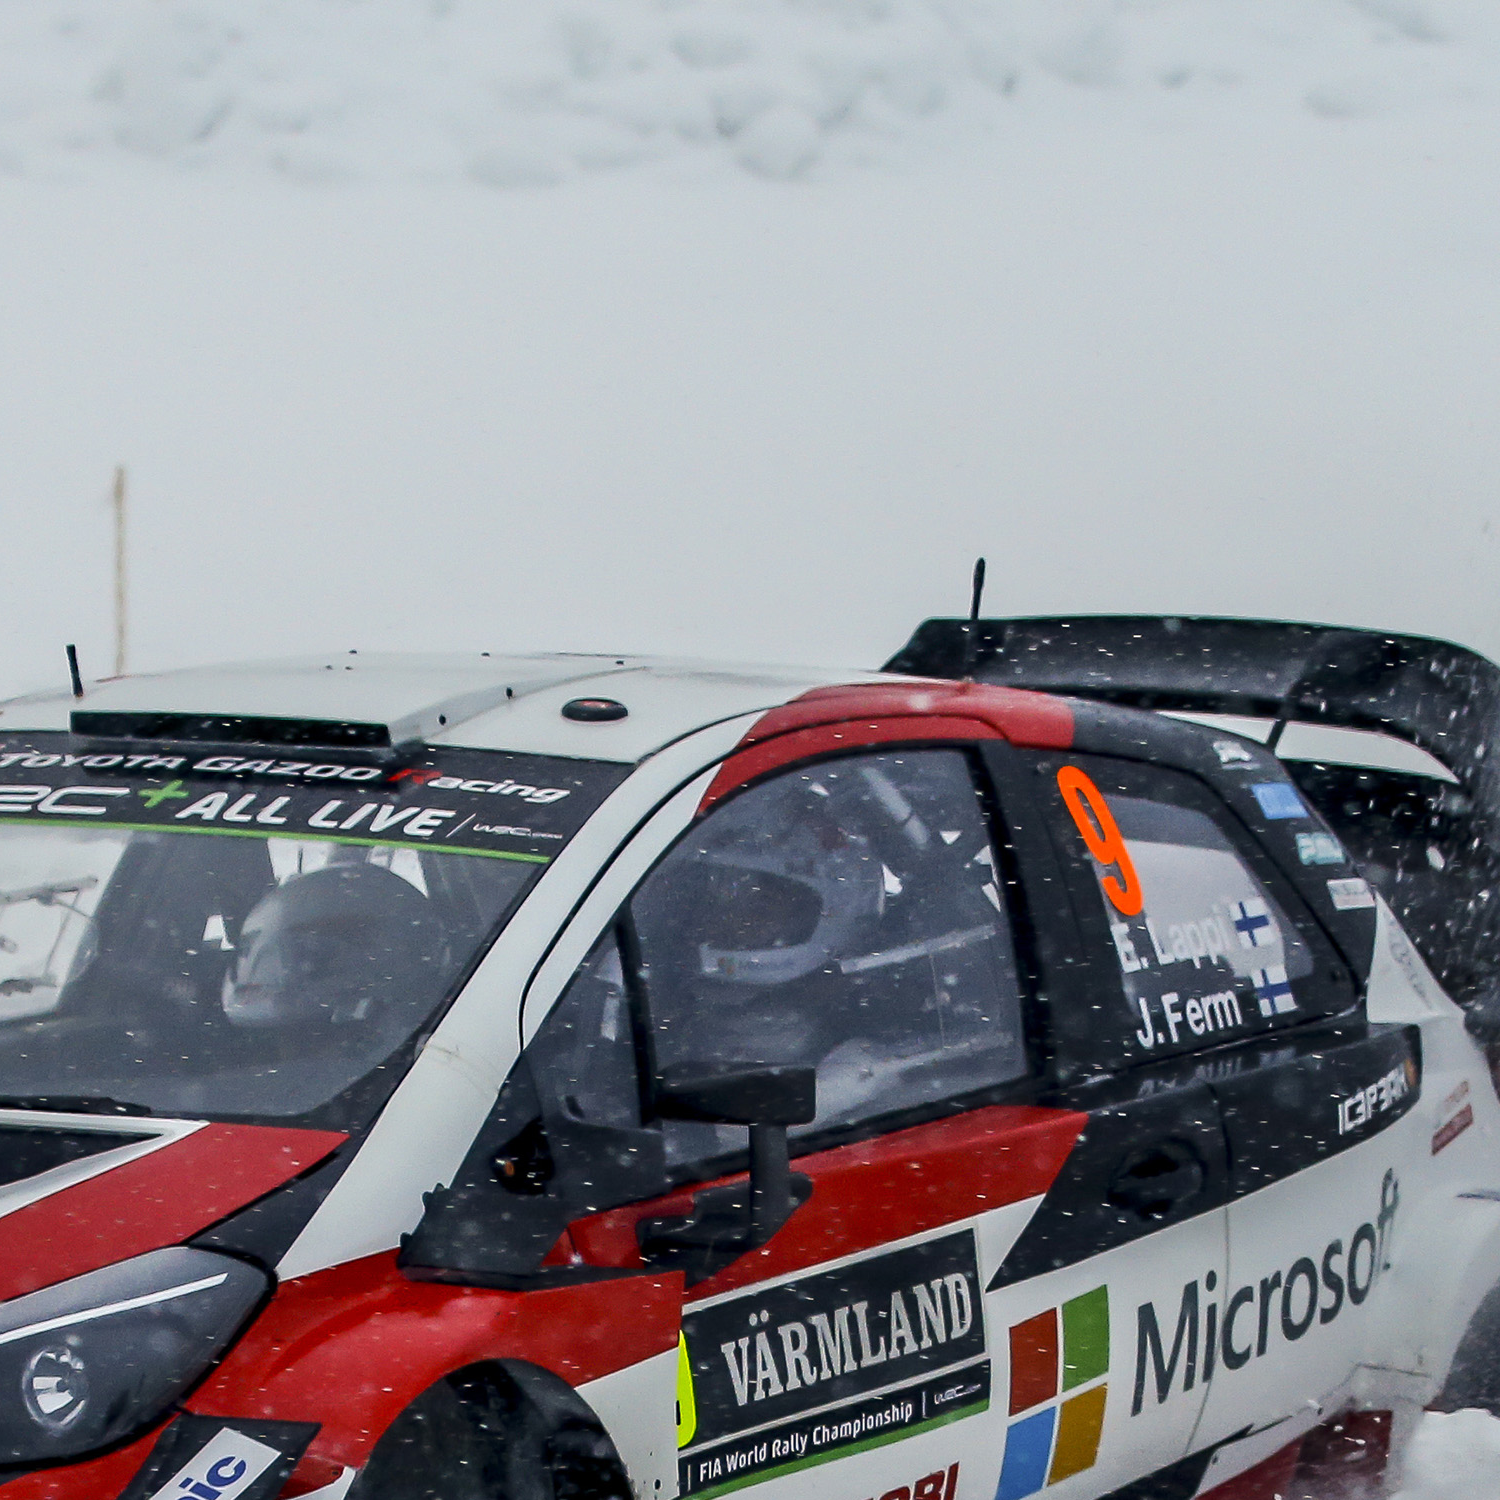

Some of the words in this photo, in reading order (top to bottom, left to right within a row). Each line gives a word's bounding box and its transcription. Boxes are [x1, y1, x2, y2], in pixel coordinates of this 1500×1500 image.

[193, 756, 381, 780] GAZOO
[175, 791, 291, 823] ALL
[308, 800, 457, 837] LIVE
[1056, 766, 1143, 917] 9
[1110, 923, 1149, 974] E.
[1136, 997, 1165, 1049] J.
[1161, 991, 1243, 1043] Ferm
[721, 1271, 973, 1406] VÄRMLAND
[700, 1459, 722, 1483] FIA
[725, 1442, 767, 1473] World
[772, 1432, 808, 1458] Rally
[813, 1401, 913, 1446] Championship
